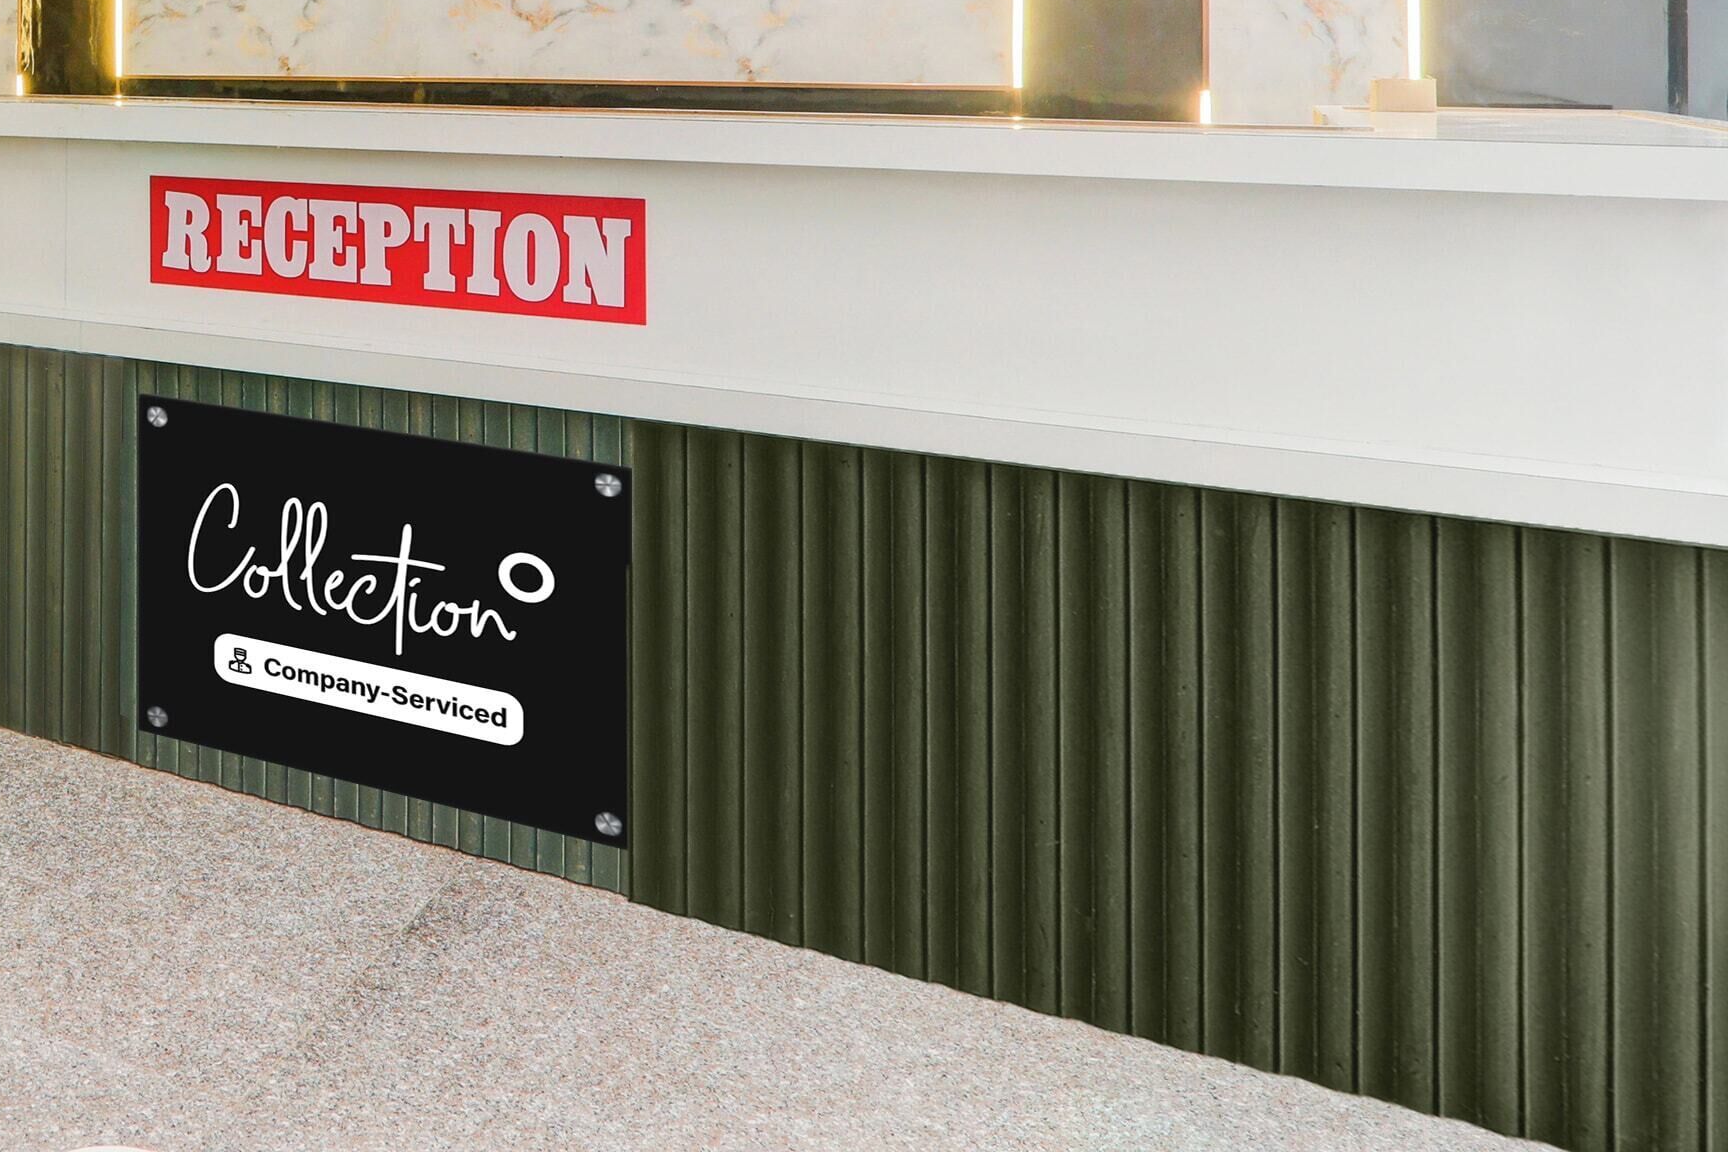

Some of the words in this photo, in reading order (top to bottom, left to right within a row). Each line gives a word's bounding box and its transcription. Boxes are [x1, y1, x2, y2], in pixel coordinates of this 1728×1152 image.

[162, 190, 632, 308] RECEPTION
[187, 482, 517, 656] Collection
[264, 657, 507, 729] Company-Serviced
